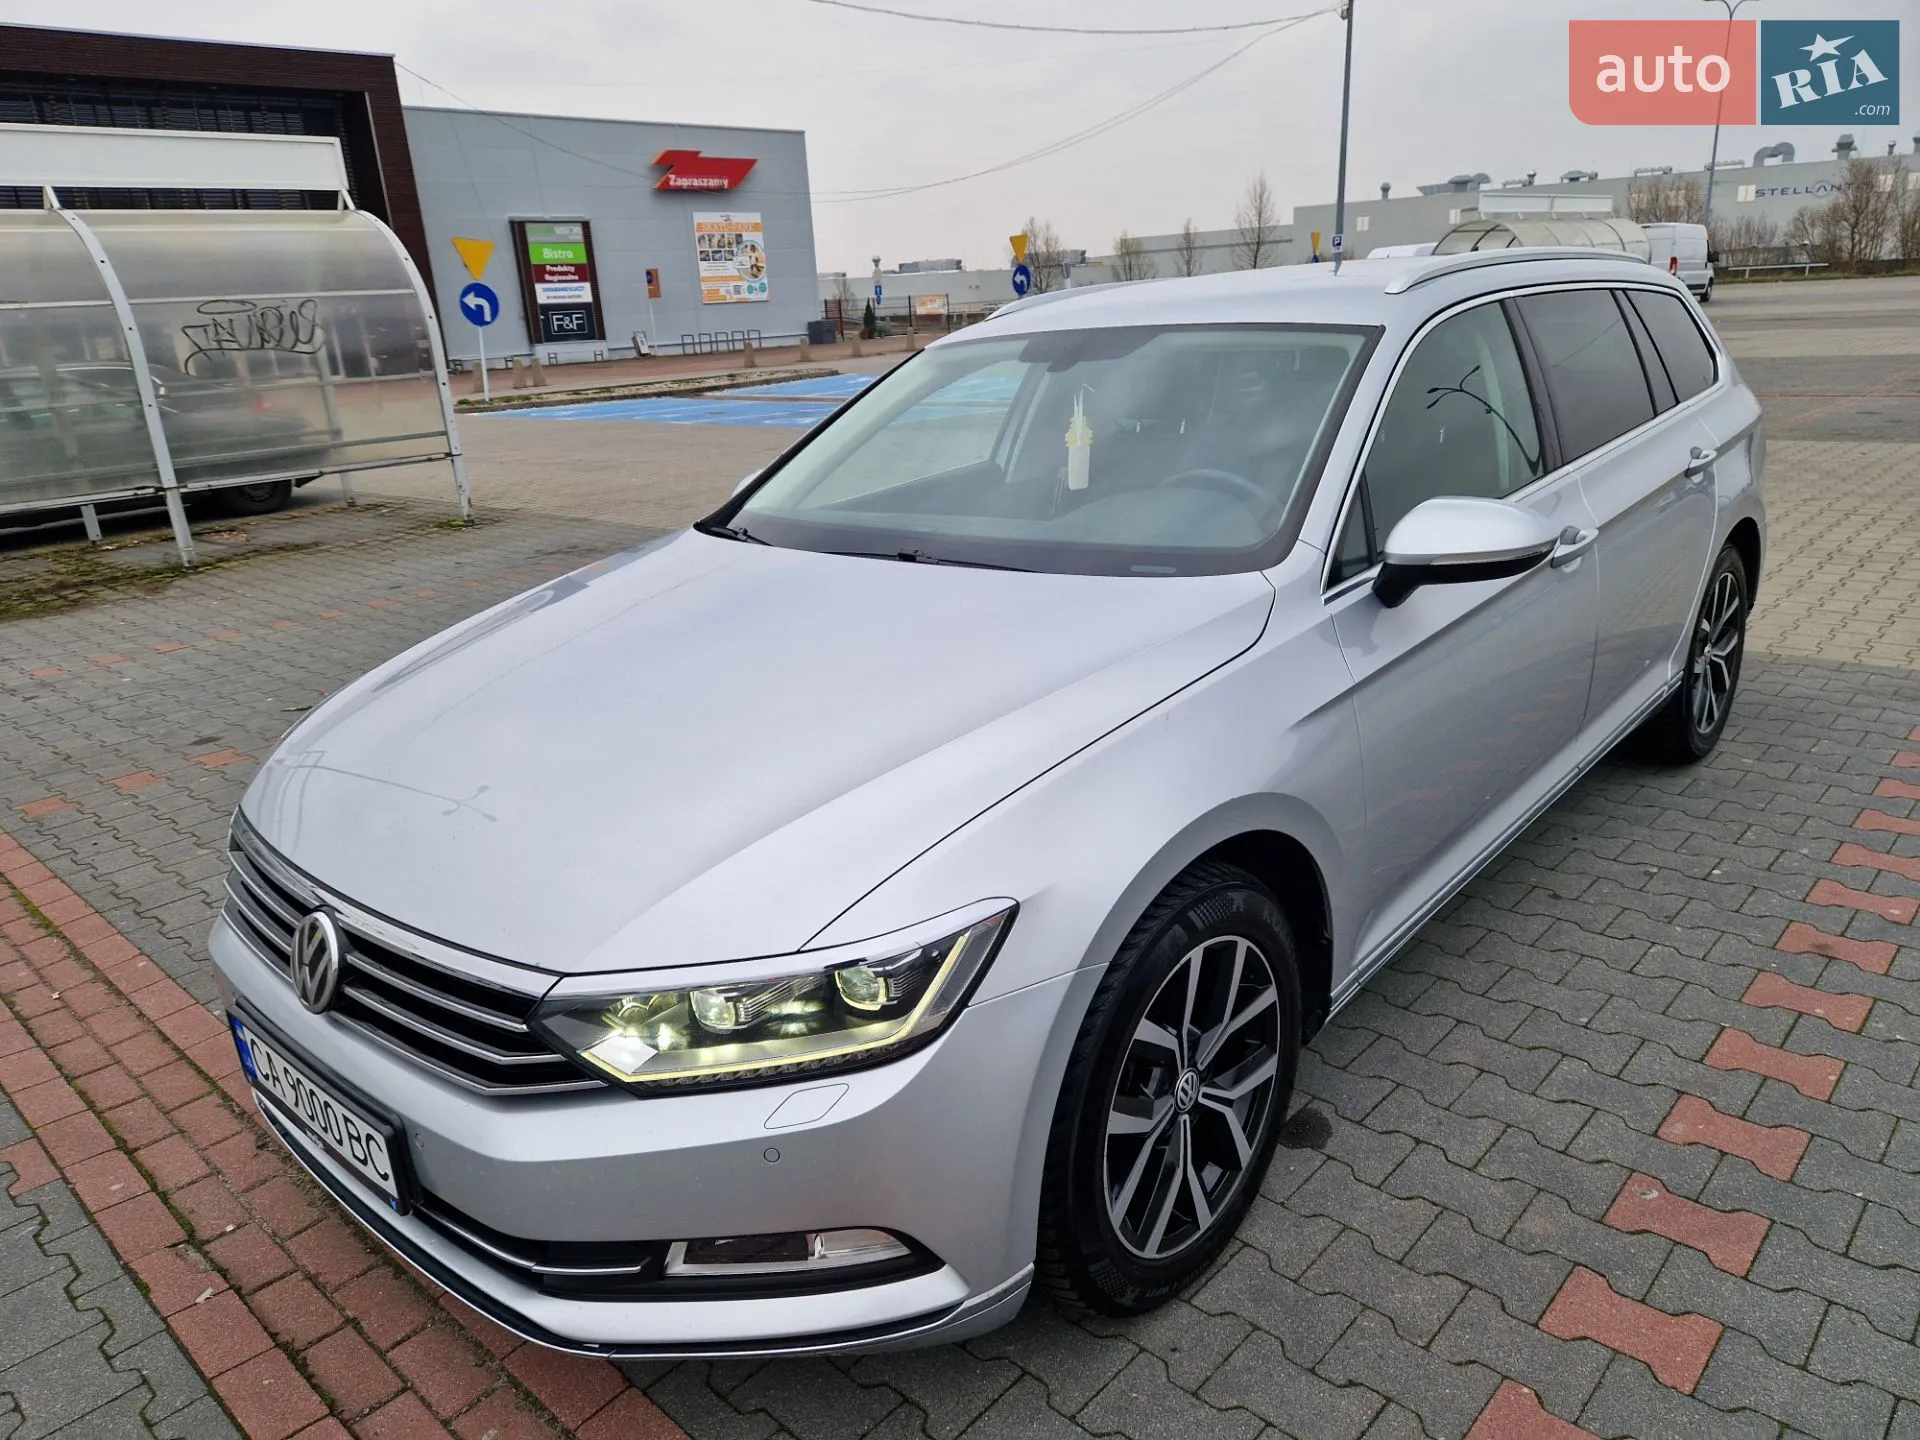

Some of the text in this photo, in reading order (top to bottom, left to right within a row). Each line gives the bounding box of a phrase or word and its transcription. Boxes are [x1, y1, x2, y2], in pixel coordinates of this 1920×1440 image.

[668, 174, 729, 189] Zapraszamy
[542, 247, 574, 259] Bistro
[552, 314, 584, 331] F&F
[250, 1038, 389, 1181] CA 9000 BC
